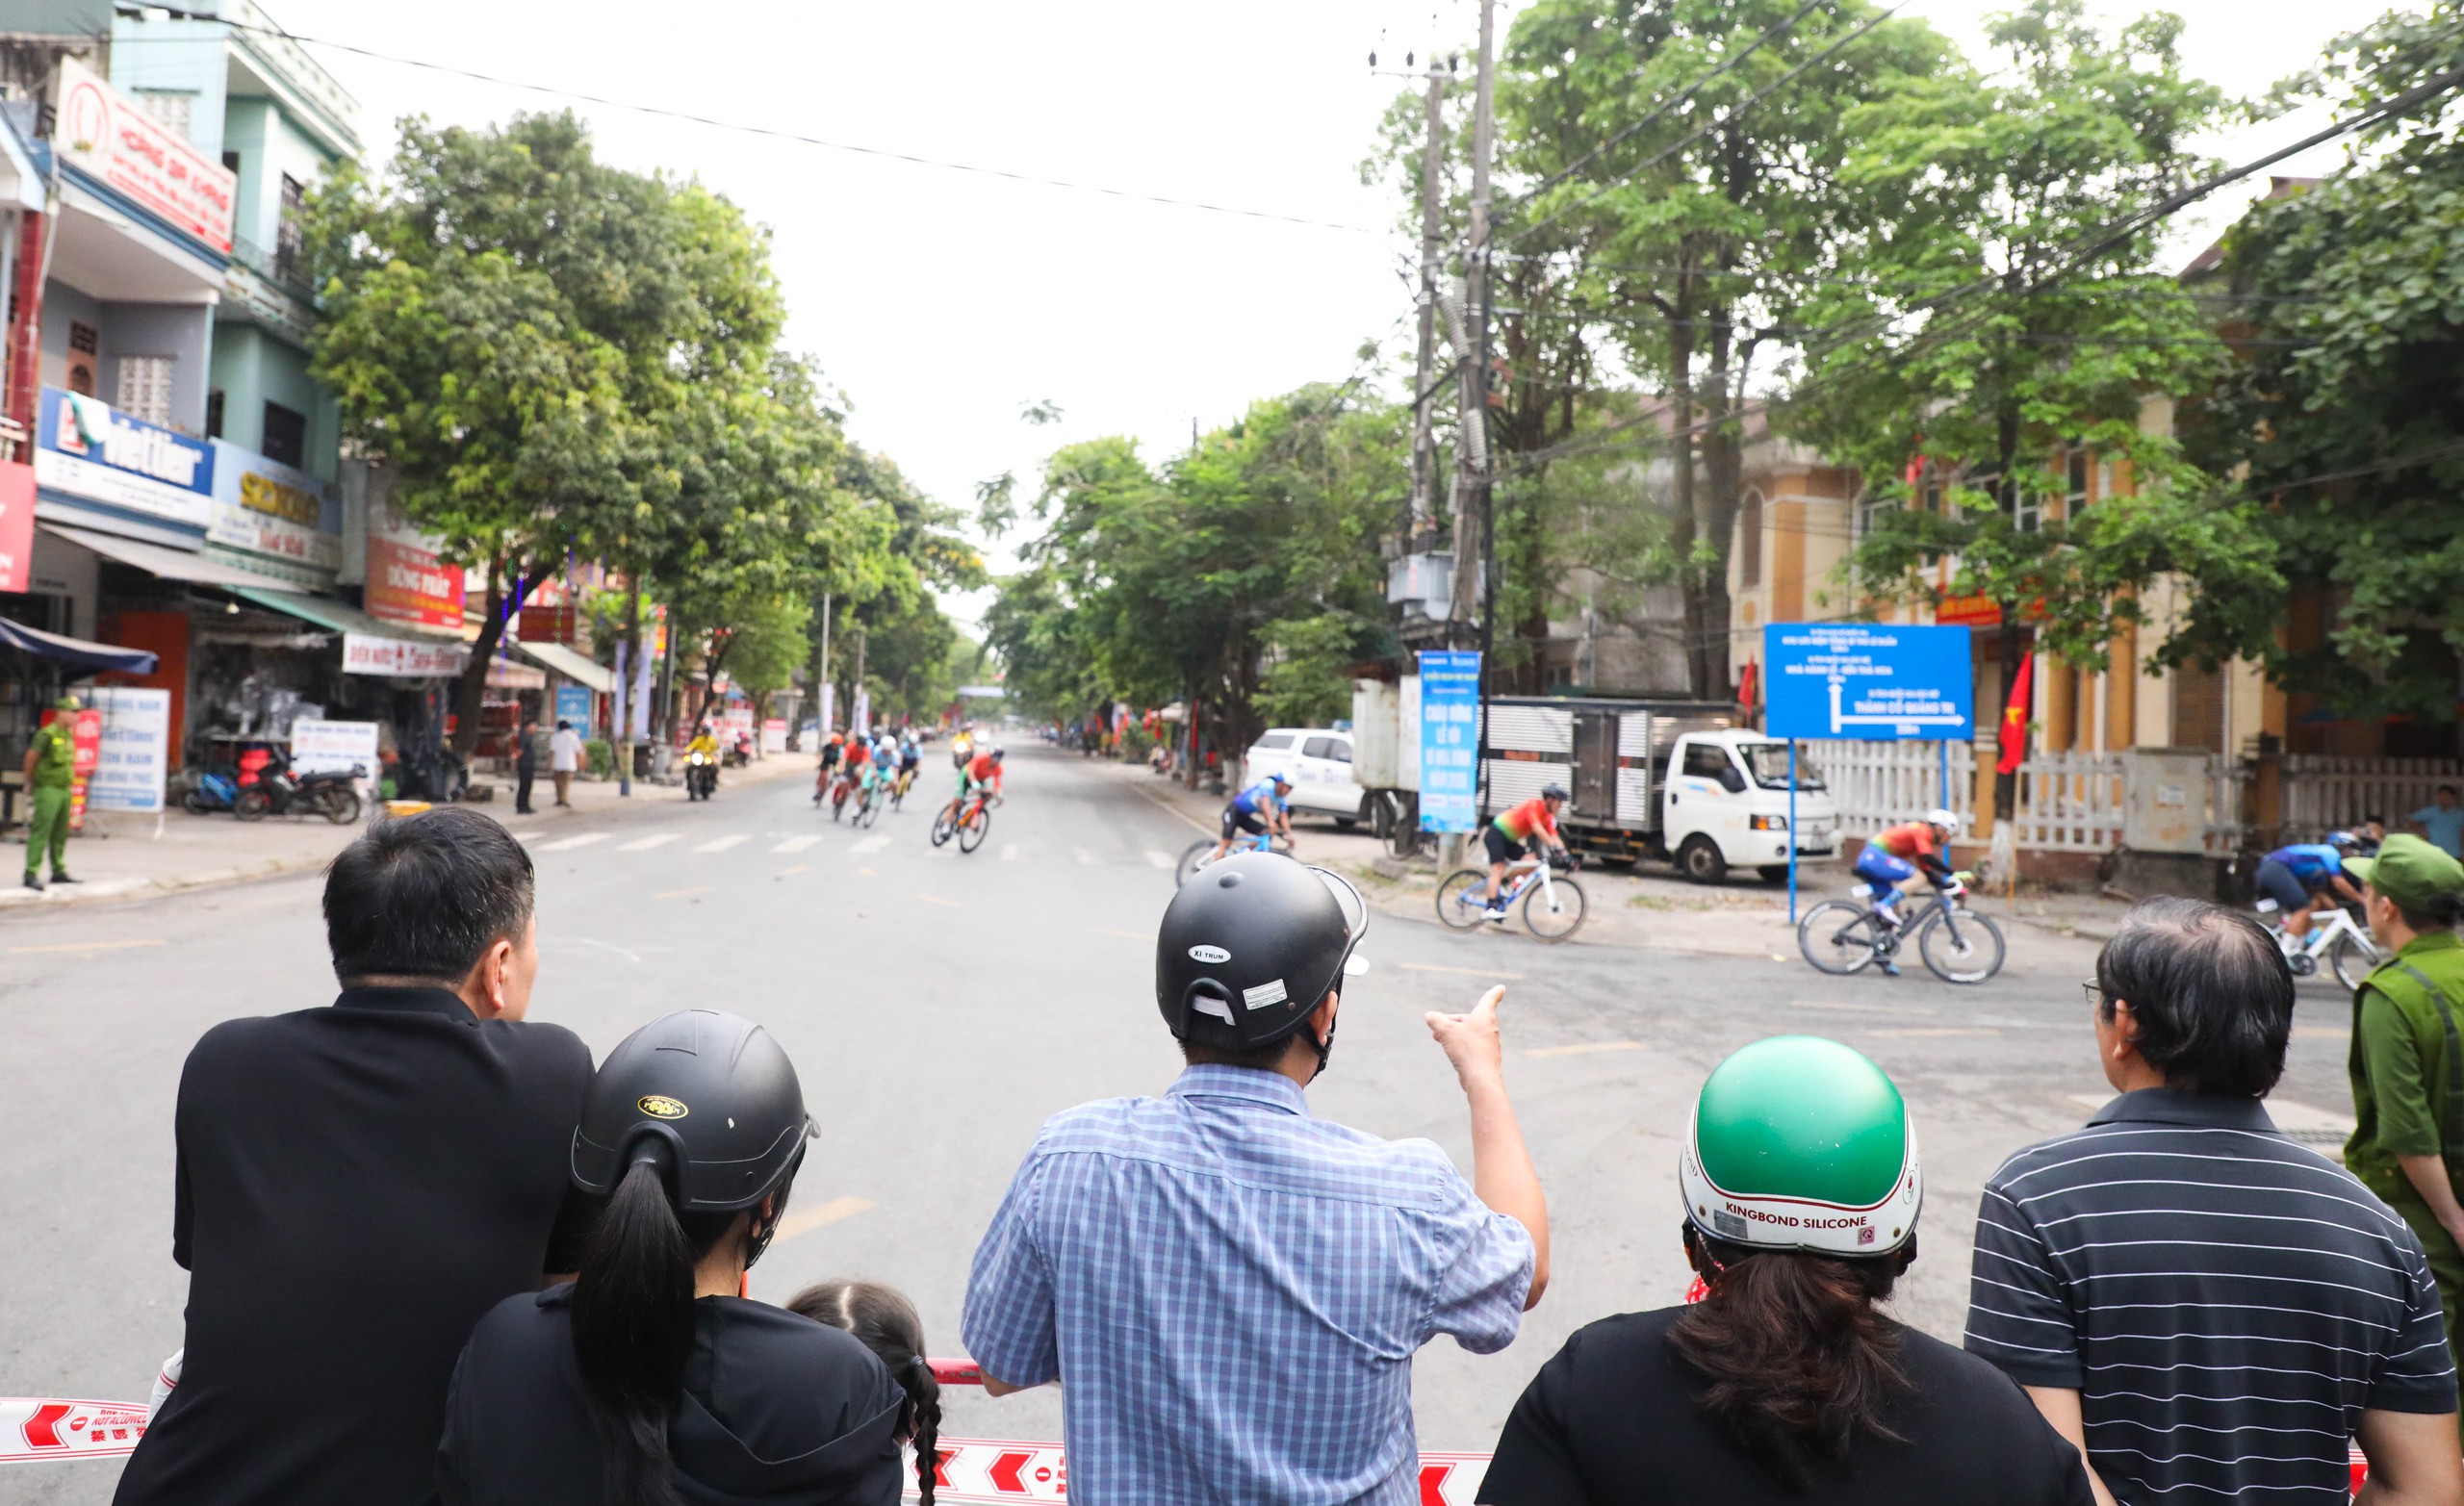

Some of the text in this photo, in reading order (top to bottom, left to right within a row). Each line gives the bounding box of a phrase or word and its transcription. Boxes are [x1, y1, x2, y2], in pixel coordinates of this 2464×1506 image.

[1726, 1202, 1867, 1229] KINGBOND SILICONE
[91, 1417, 110, 1425] NOT
